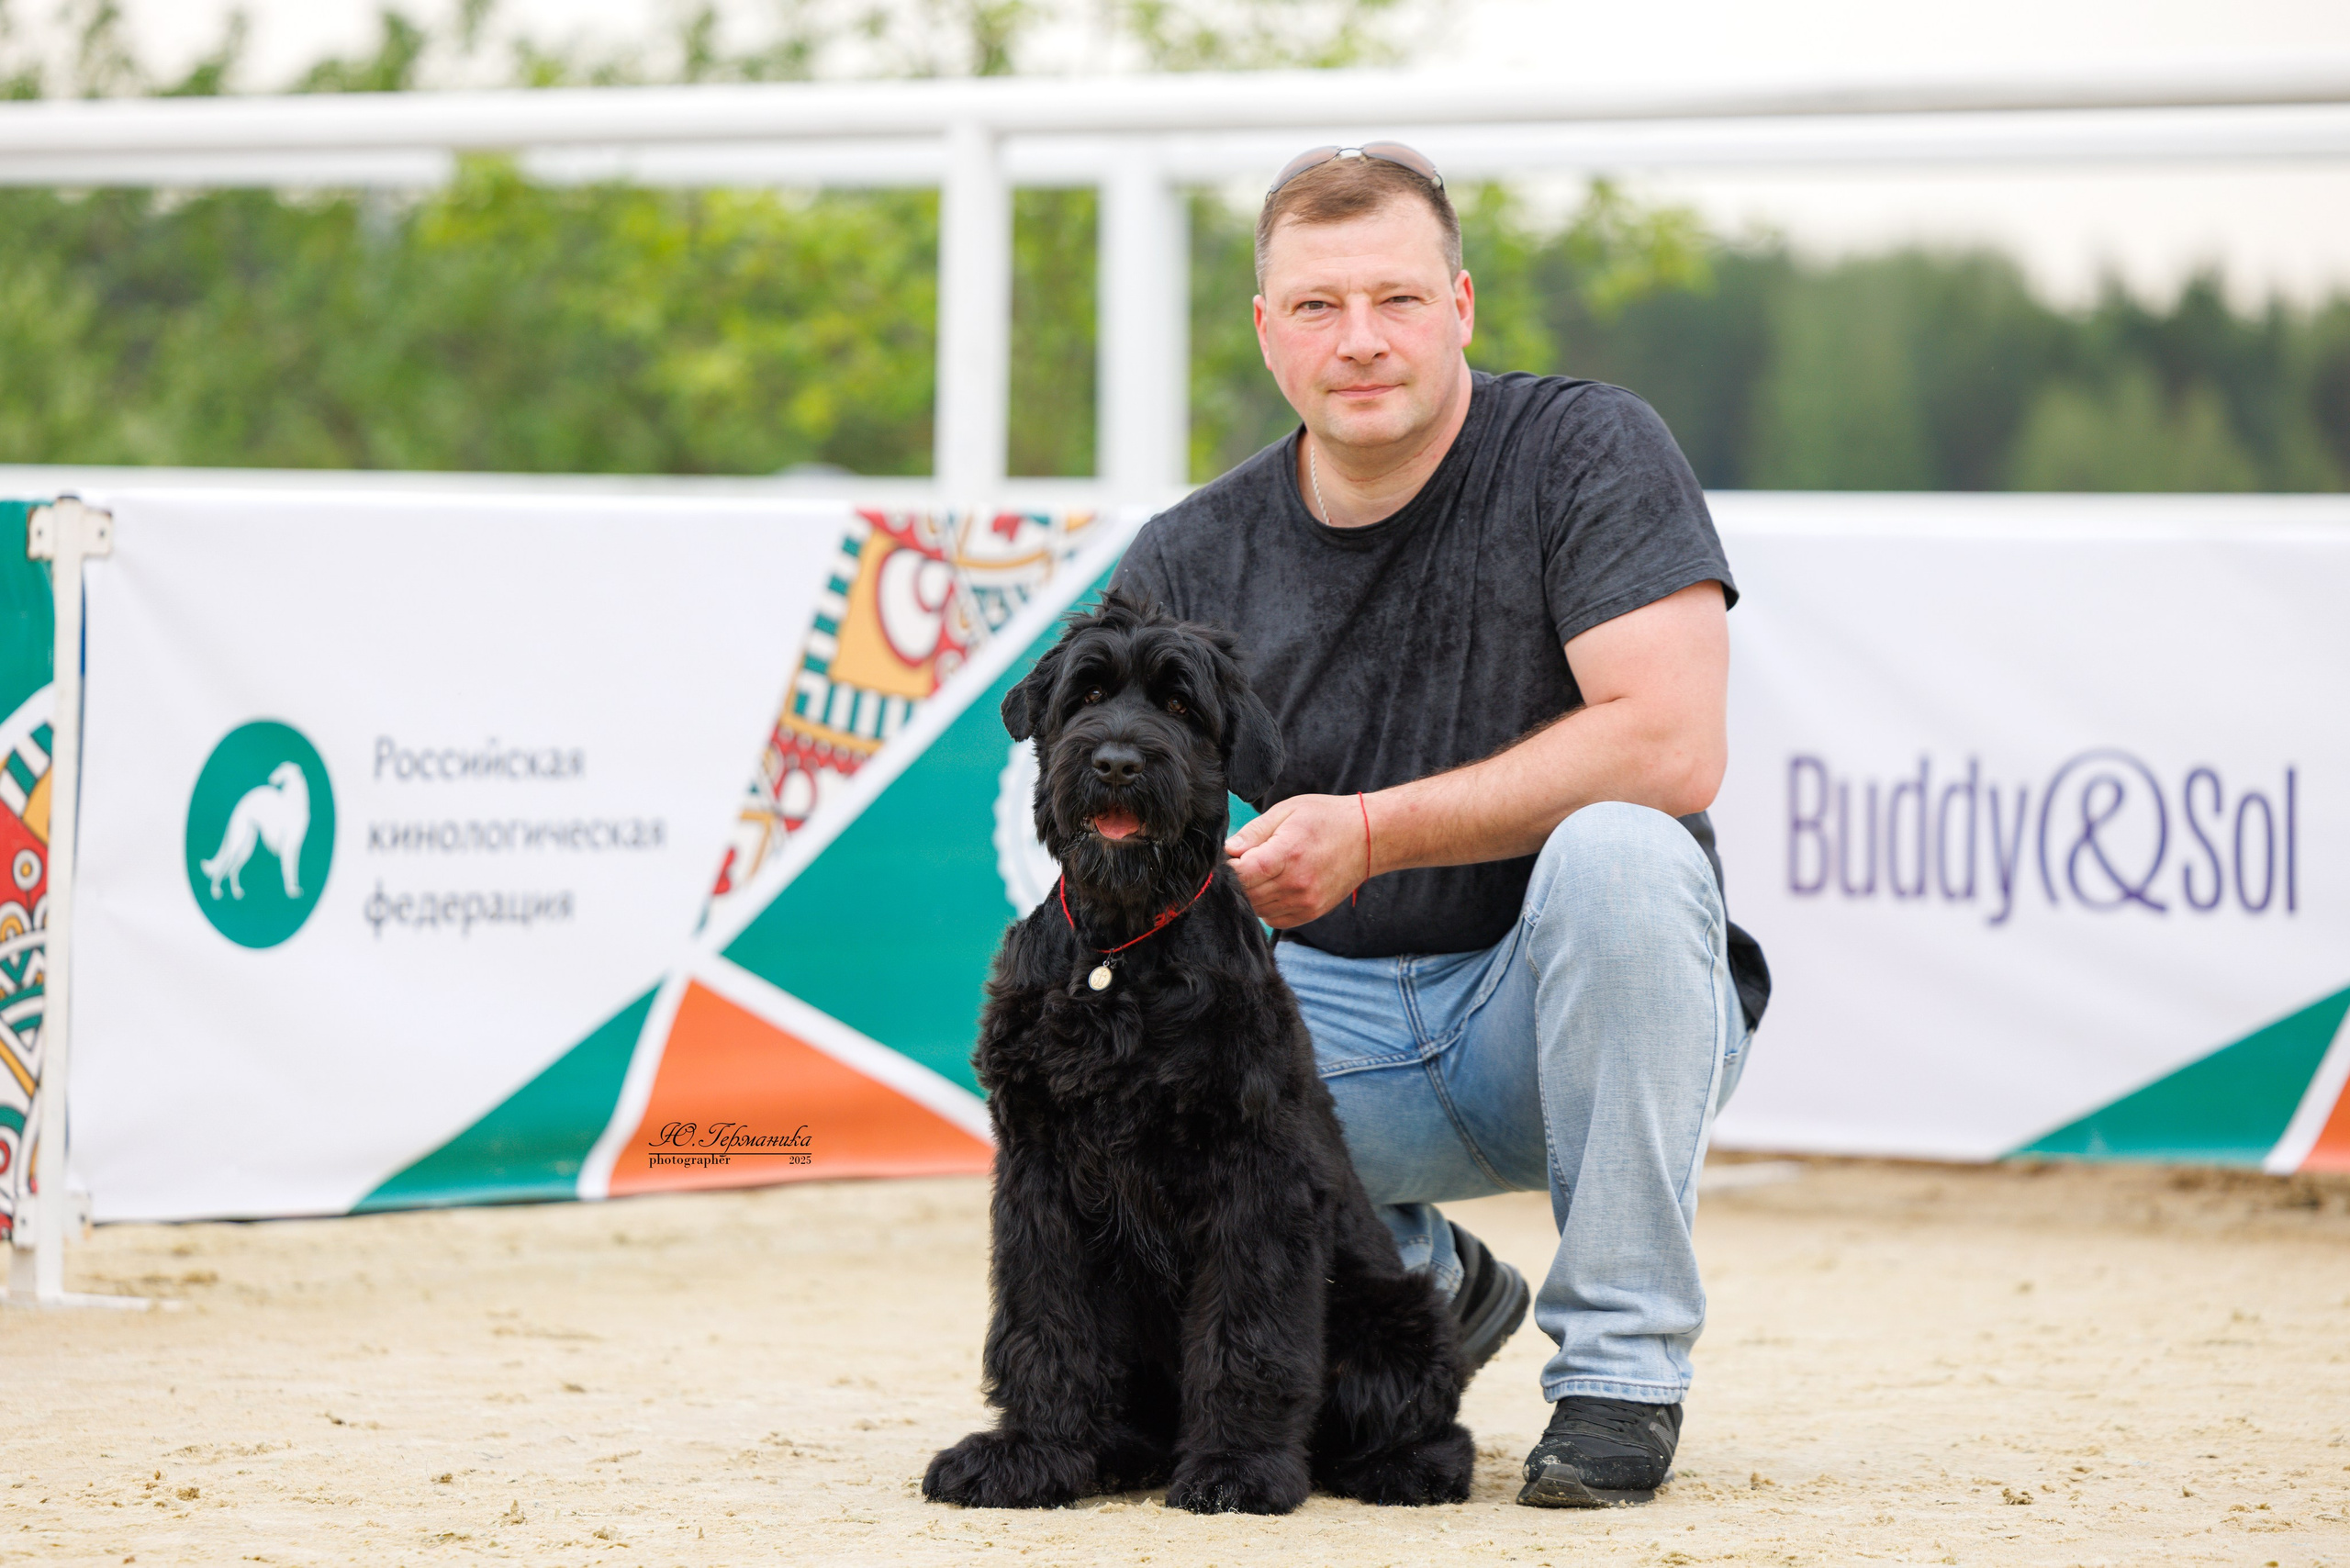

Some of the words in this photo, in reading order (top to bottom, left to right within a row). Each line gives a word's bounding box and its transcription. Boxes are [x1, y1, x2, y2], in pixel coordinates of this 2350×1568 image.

[374, 734, 585, 779] Российская
[366, 818, 665, 852] кинологическая
[364, 878, 574, 938] федерация
